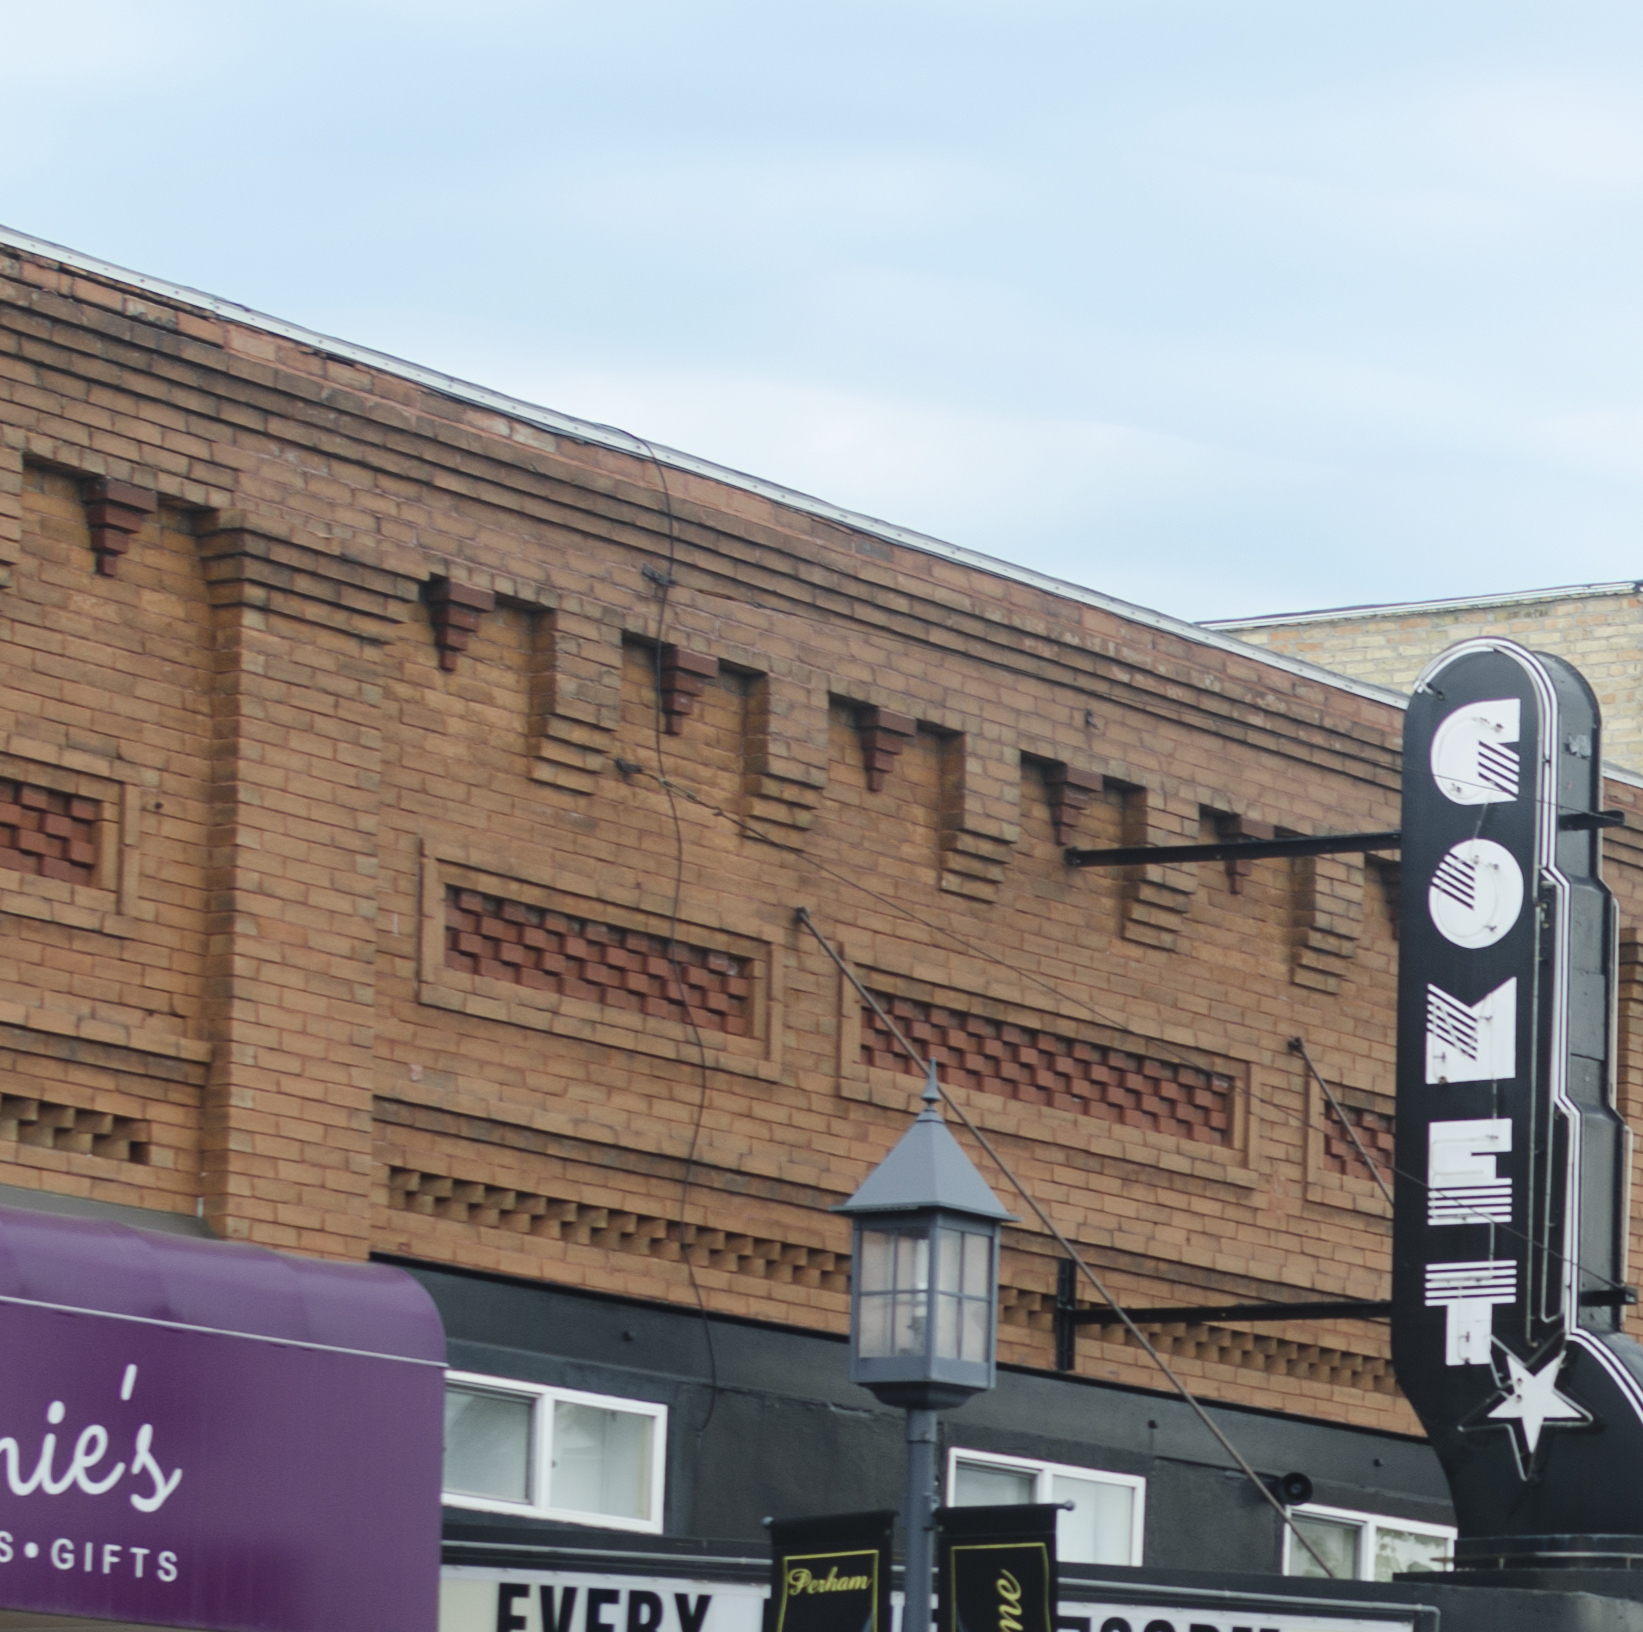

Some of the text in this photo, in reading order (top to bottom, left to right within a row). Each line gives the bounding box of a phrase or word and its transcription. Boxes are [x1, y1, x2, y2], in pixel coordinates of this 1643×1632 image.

[1424, 698, 1524, 1367] COMET
[51, 1538, 178, 1582] GIFTS
[787, 1566, 873, 1596] Perham
